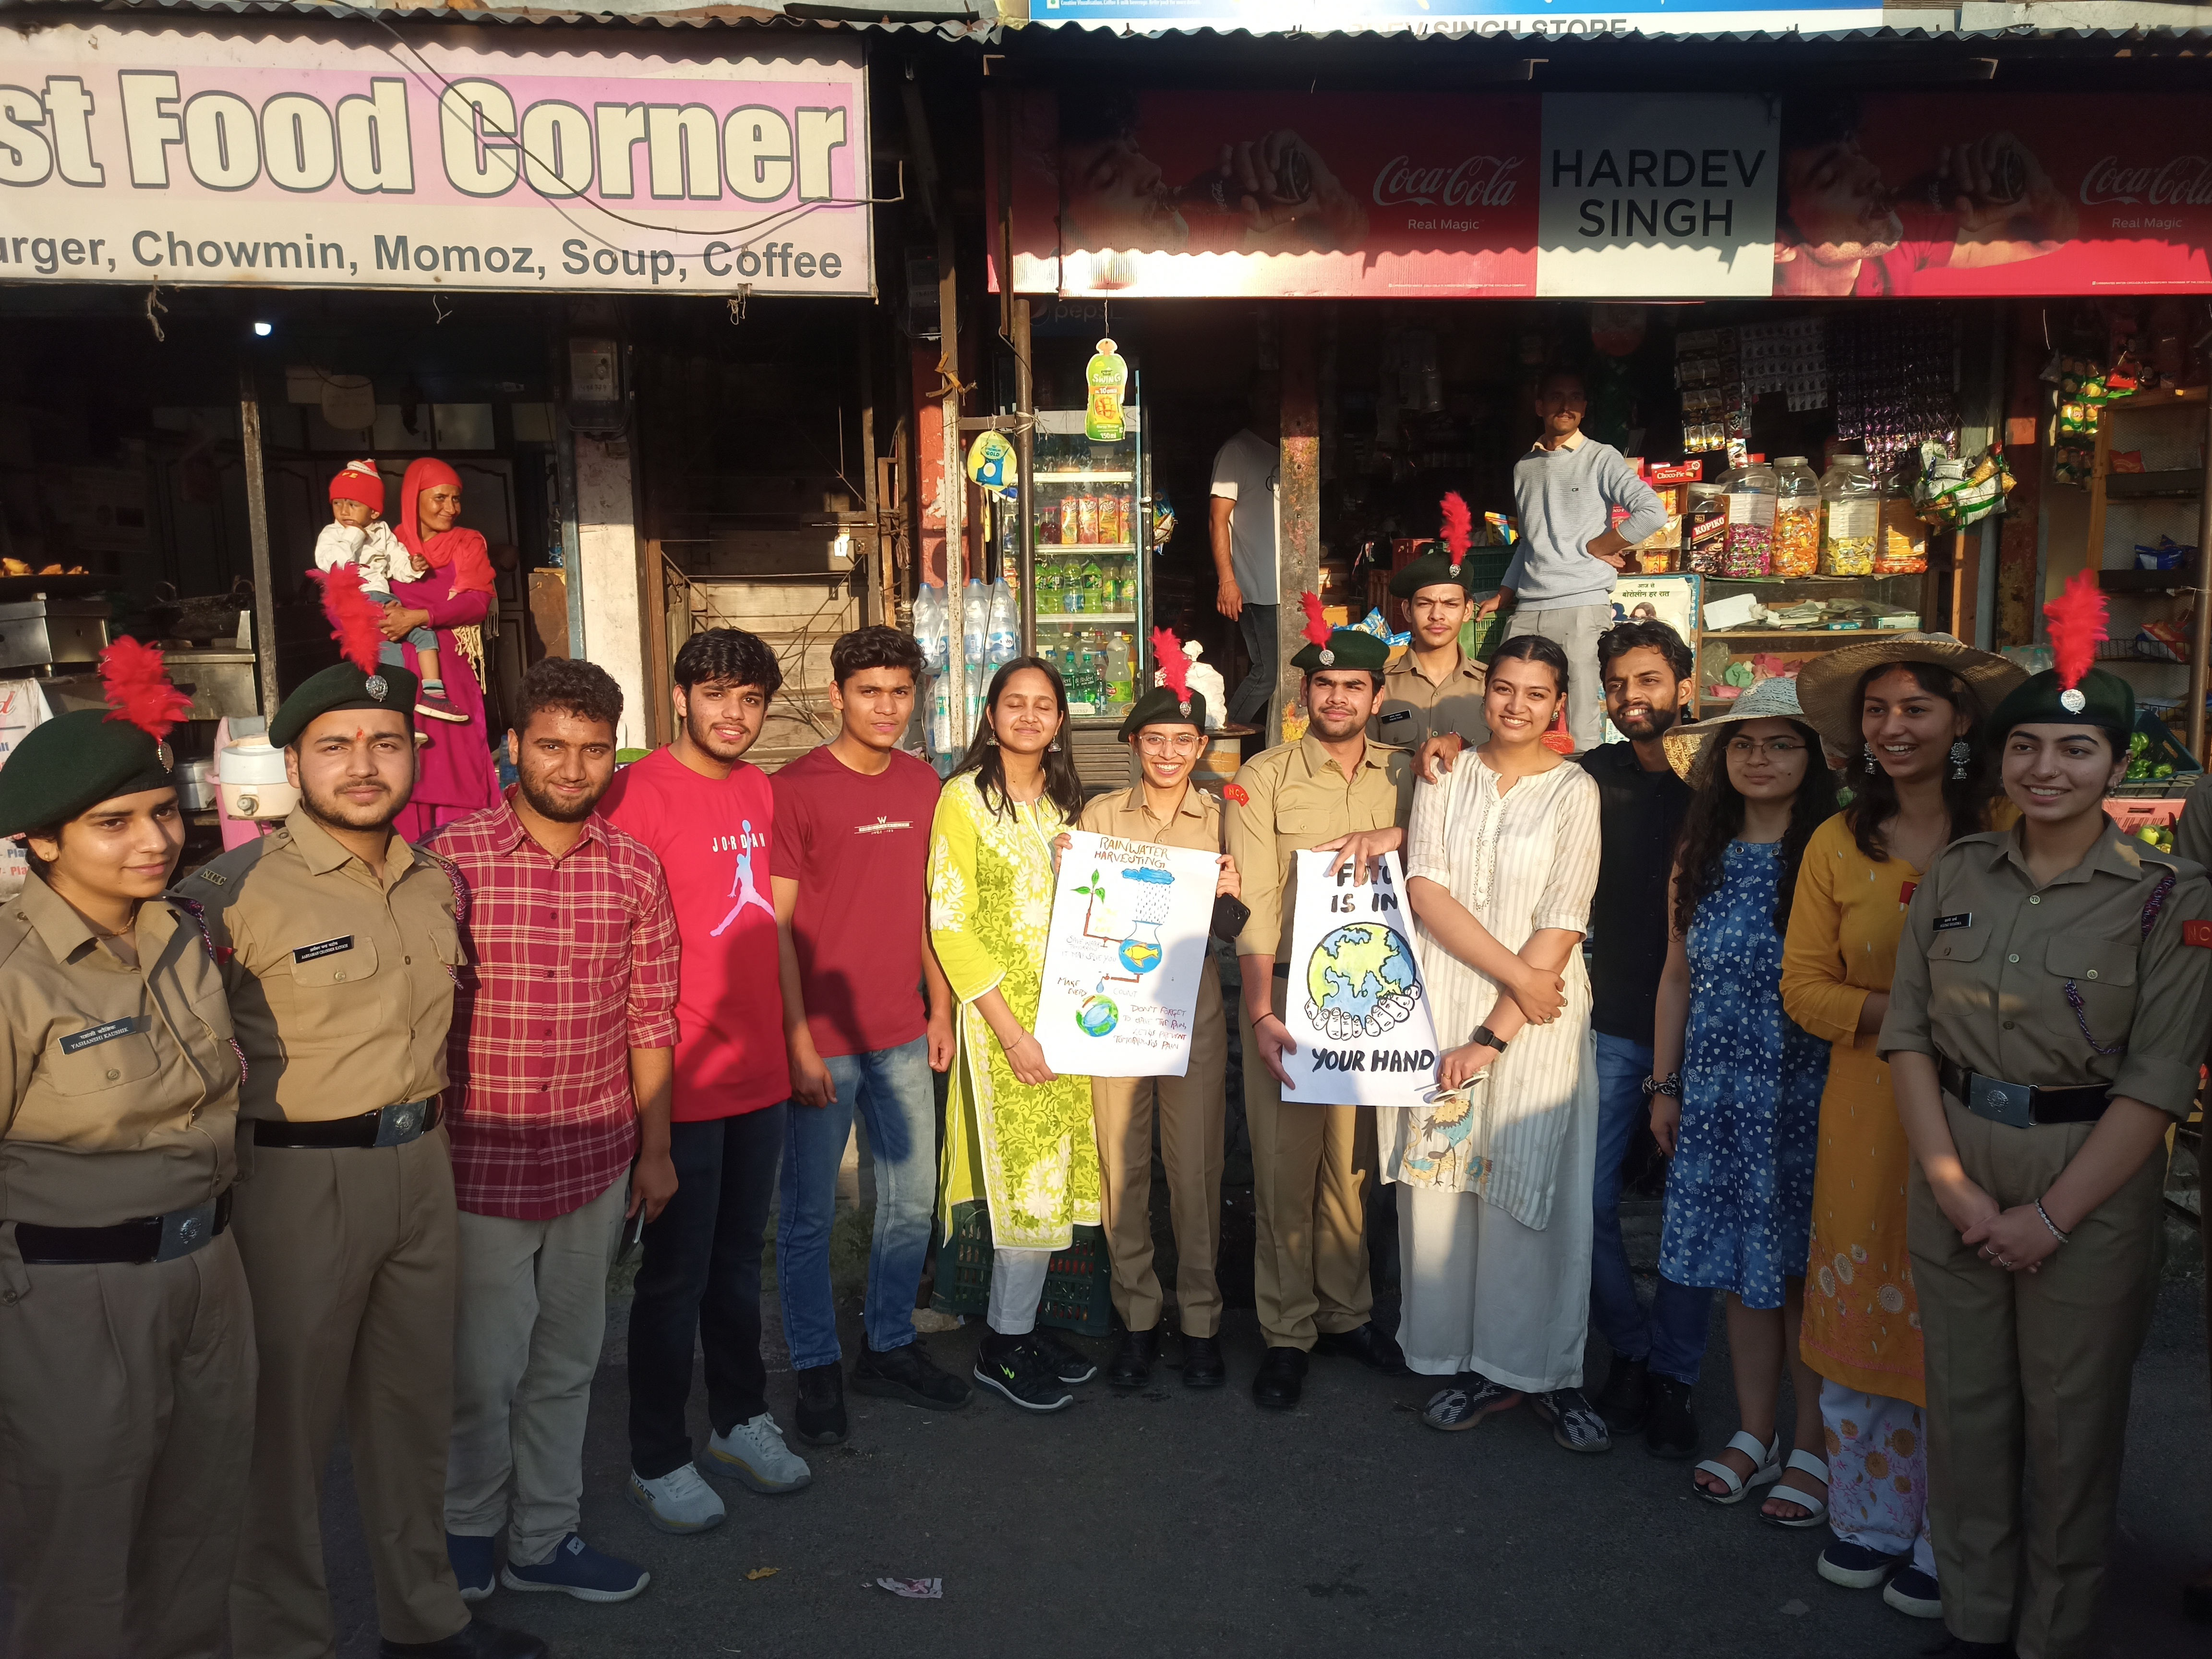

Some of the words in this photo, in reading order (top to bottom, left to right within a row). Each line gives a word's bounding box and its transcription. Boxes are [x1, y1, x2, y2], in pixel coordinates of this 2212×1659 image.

[118, 69, 416, 194] Food
[439, 77, 847, 203] Corner
[1552, 149, 1767, 188] HARDEV
[1372, 155, 1527, 206] Coca-Cola
[1407, 218, 1437, 229] Real
[1441, 218, 1479, 232] Magic
[1578, 198, 1733, 237] SINGH
[2112, 217, 2140, 228] Real
[2144, 217, 2183, 230] Magic
[132, 230, 359, 276] Chowmin,
[373, 234, 546, 280] Momoz,
[562, 239, 687, 285] Soup,
[703, 240, 843, 278] Coffee
[1055, 304, 1114, 323] pepsi
[1694, 517, 1725, 535] KOPIKO
[1229, 787, 1245, 801] NCC
[712, 833, 766, 853] JORDAN
[1100, 837, 1171, 861] RAINWATER
[1094, 851, 1165, 868] HARVESTING
[200, 868, 227, 886] NCC
[1331, 893, 1355, 913] IS
[1371, 892, 1398, 912] IN
[1103, 955, 1117, 964] YOU
[1058, 977, 1081, 986] MAKE
[1068, 988, 1088, 997] EVERY
[1113, 987, 1138, 998] COUNT
[1130, 1004, 1158, 1013] DON'T
[1160, 1006, 1187, 1018] FORGET
[1155, 1018, 1169, 1026] THE
[71, 1035, 103, 1049] YASHANSHI
[104, 1026, 129, 1039] KAUSHIK
[1161, 1041, 1178, 1050] PAIN
[1311, 1048, 1365, 1072] YOUR
[1370, 1048, 1435, 1073] HAND
